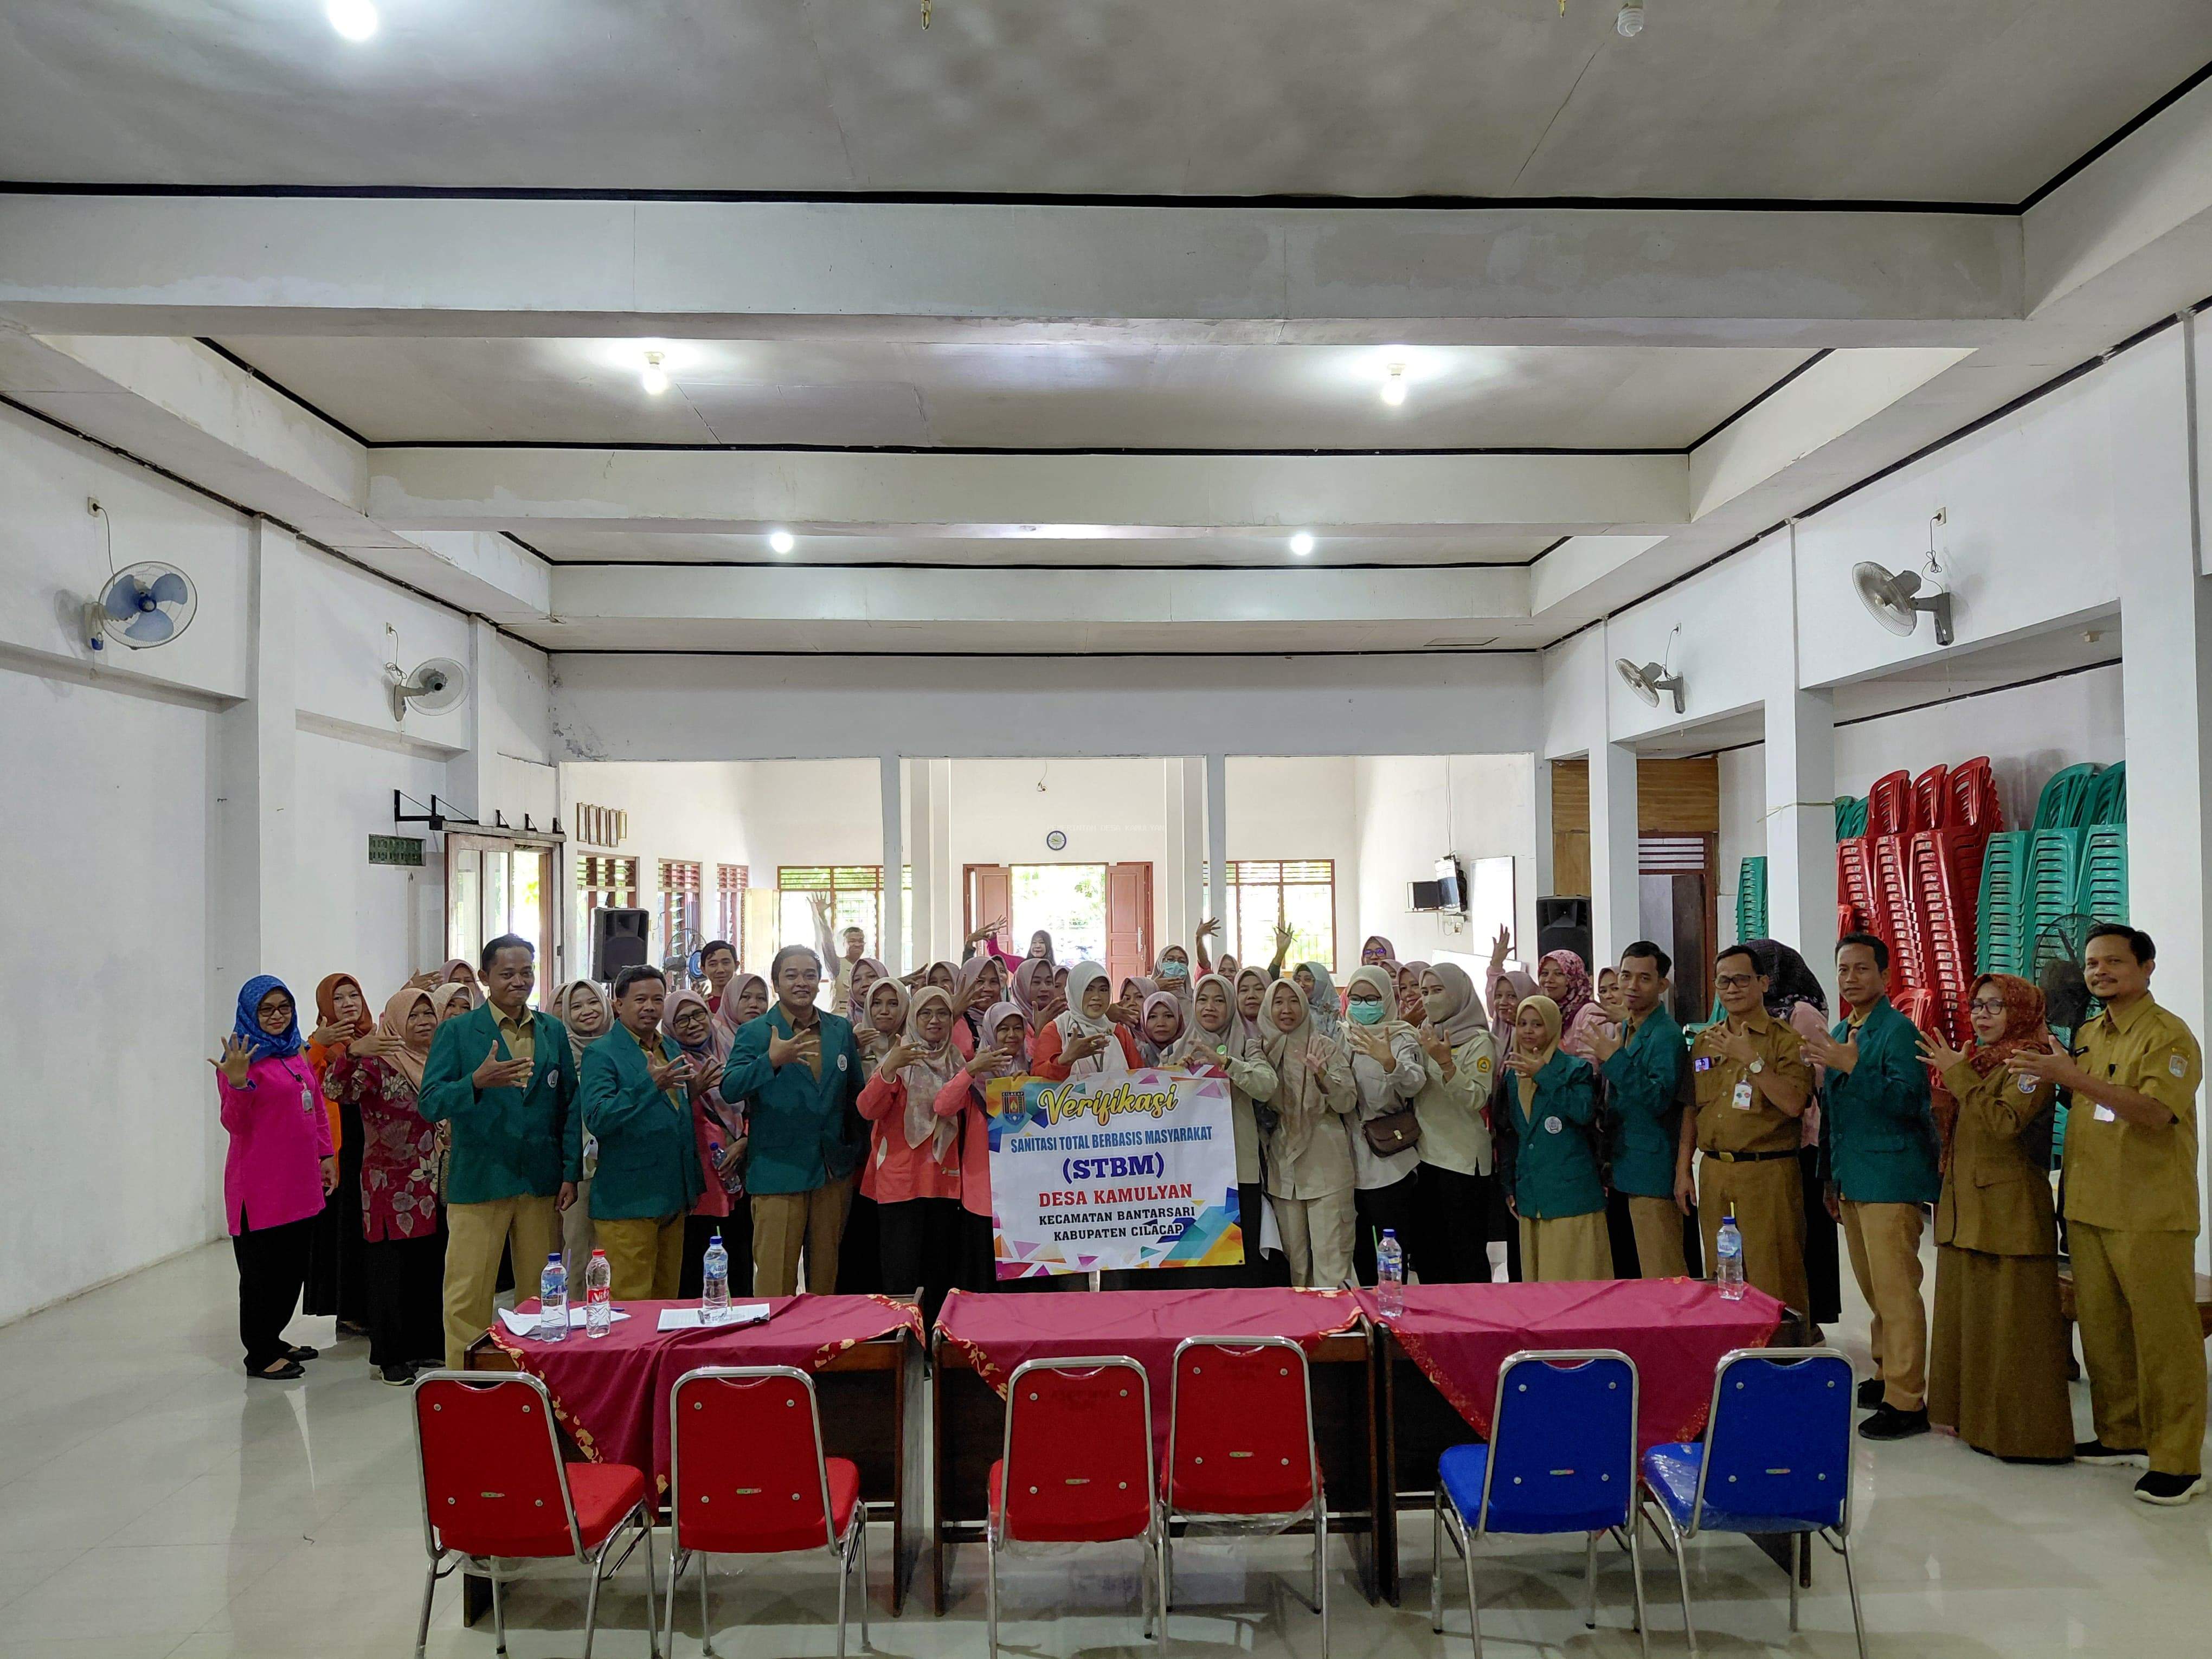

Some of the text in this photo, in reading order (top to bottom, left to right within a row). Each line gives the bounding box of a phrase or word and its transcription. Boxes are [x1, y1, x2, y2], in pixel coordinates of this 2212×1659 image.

[1039, 1083, 1179, 1125] Verifikasi
[1011, 1126, 1212, 1153] SANITASI TOTAL BERBASIS MASYARAKAT
[1063, 1152, 1165, 1184] (STBM)
[1039, 1184, 1192, 1207] DESA KAMULYAN
[1039, 1206, 1195, 1226] KECAMATAN BANTARSARI
[1054, 1224, 1184, 1242] KABUPATEN CILACAP
